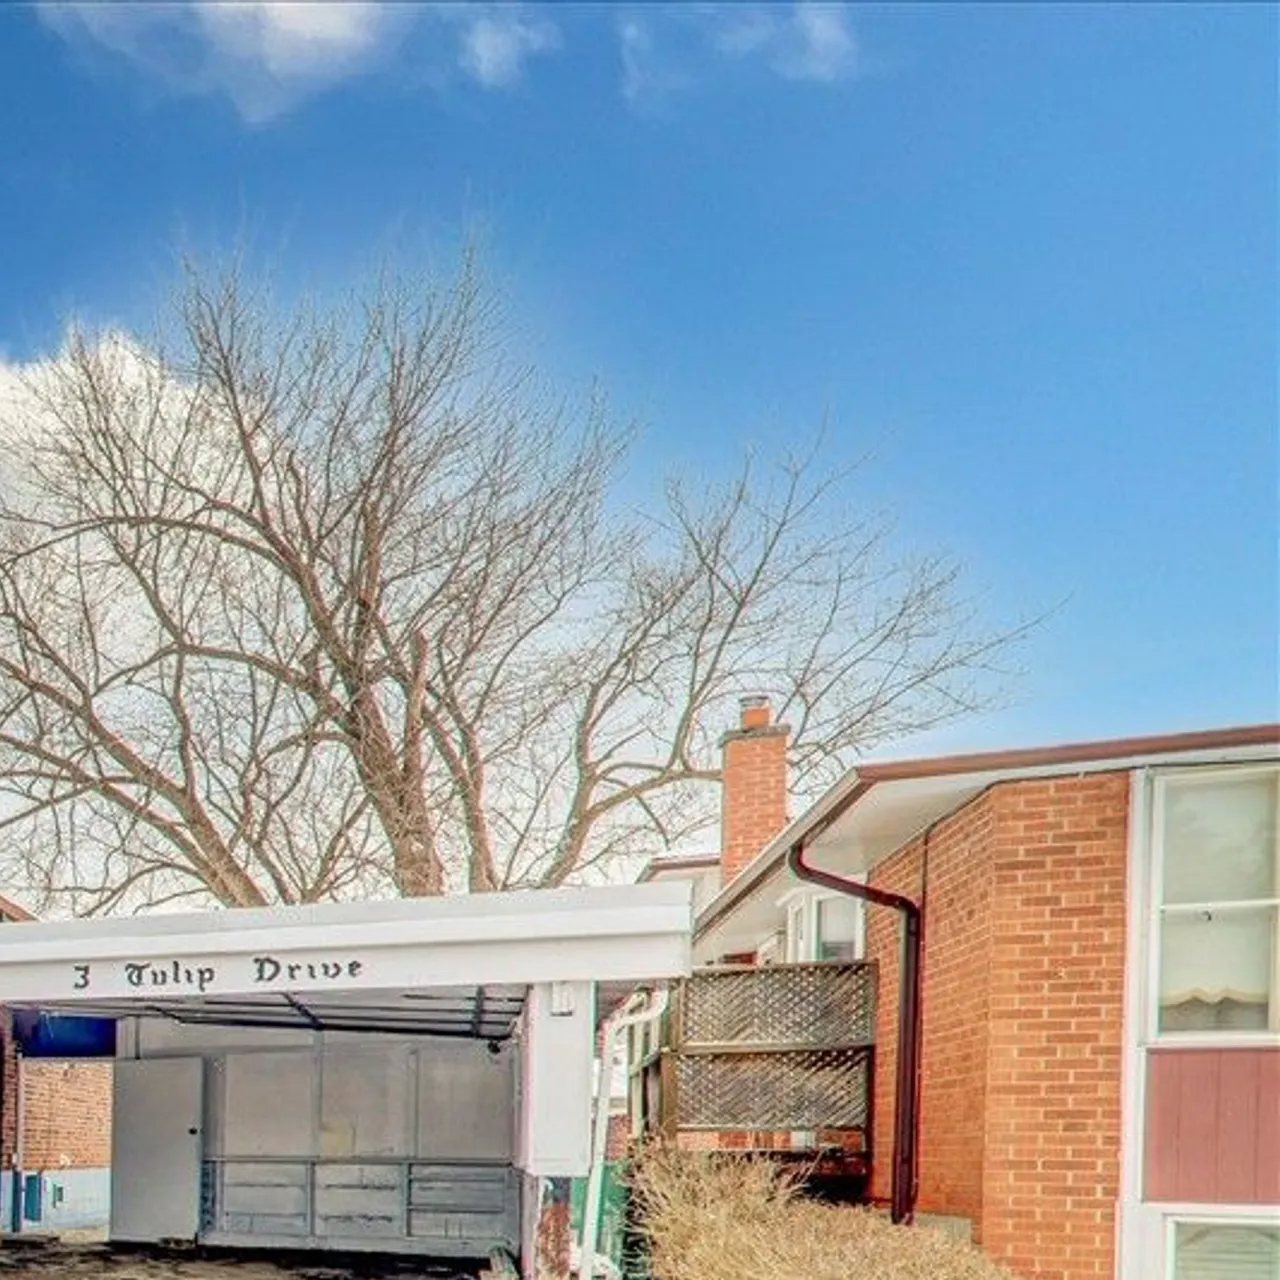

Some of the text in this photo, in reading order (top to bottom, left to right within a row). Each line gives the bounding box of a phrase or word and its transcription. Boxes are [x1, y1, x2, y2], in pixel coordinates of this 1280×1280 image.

[73, 956, 362, 991] 3 Tulip Drive
